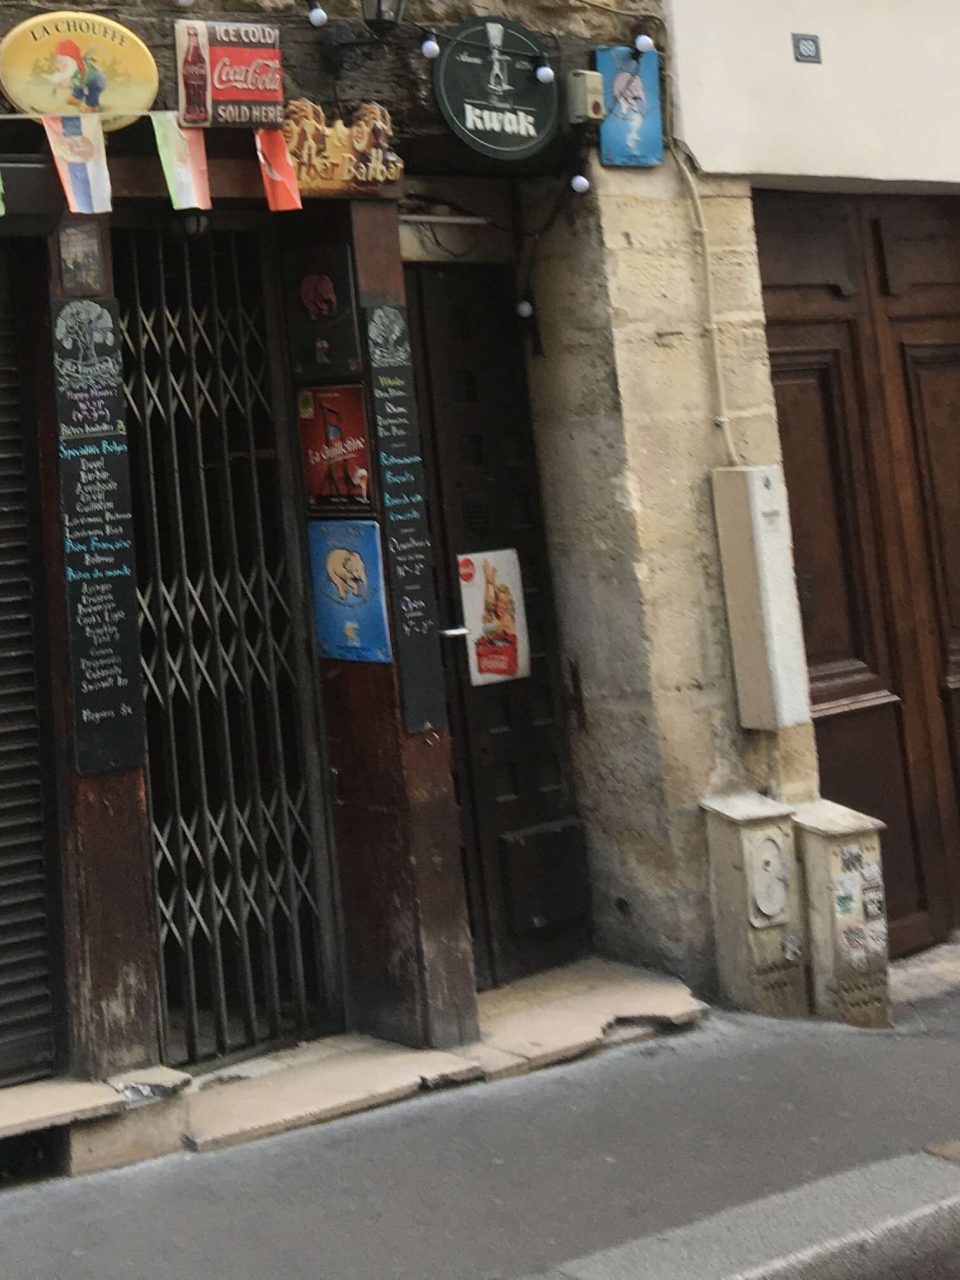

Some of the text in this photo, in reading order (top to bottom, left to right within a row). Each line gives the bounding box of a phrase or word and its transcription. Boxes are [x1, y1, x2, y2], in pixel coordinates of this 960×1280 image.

[29, 18, 128, 49] LA CHOUFFE
[215, 24, 276, 45] ICE COLD
[216, 104, 284, 123] SOLD HERE
